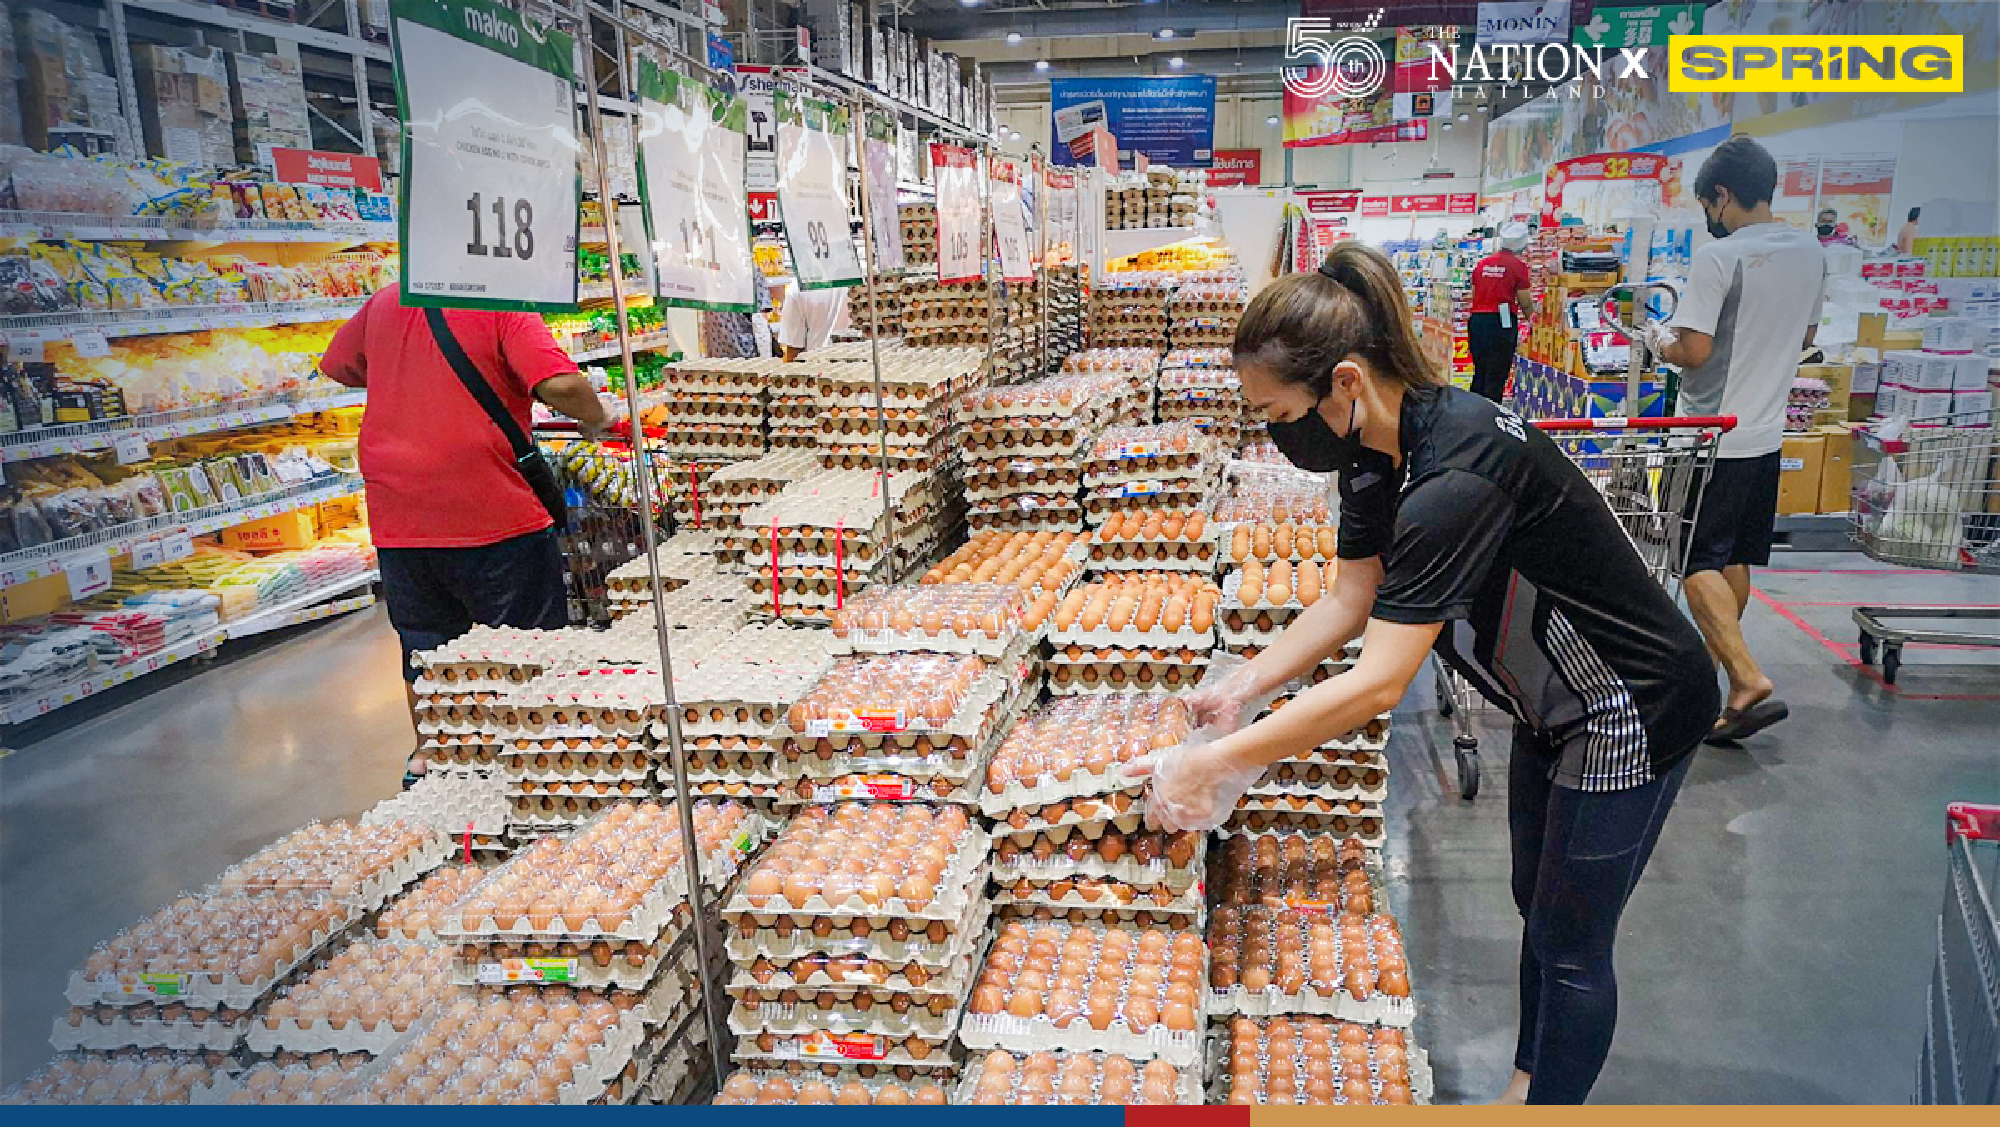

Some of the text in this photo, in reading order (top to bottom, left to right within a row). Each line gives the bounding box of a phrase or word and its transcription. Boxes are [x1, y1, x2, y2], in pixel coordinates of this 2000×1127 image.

[464, 6, 519, 49] makro
[1603, 158, 1631, 178] 32
[467, 192, 534, 260] 118
